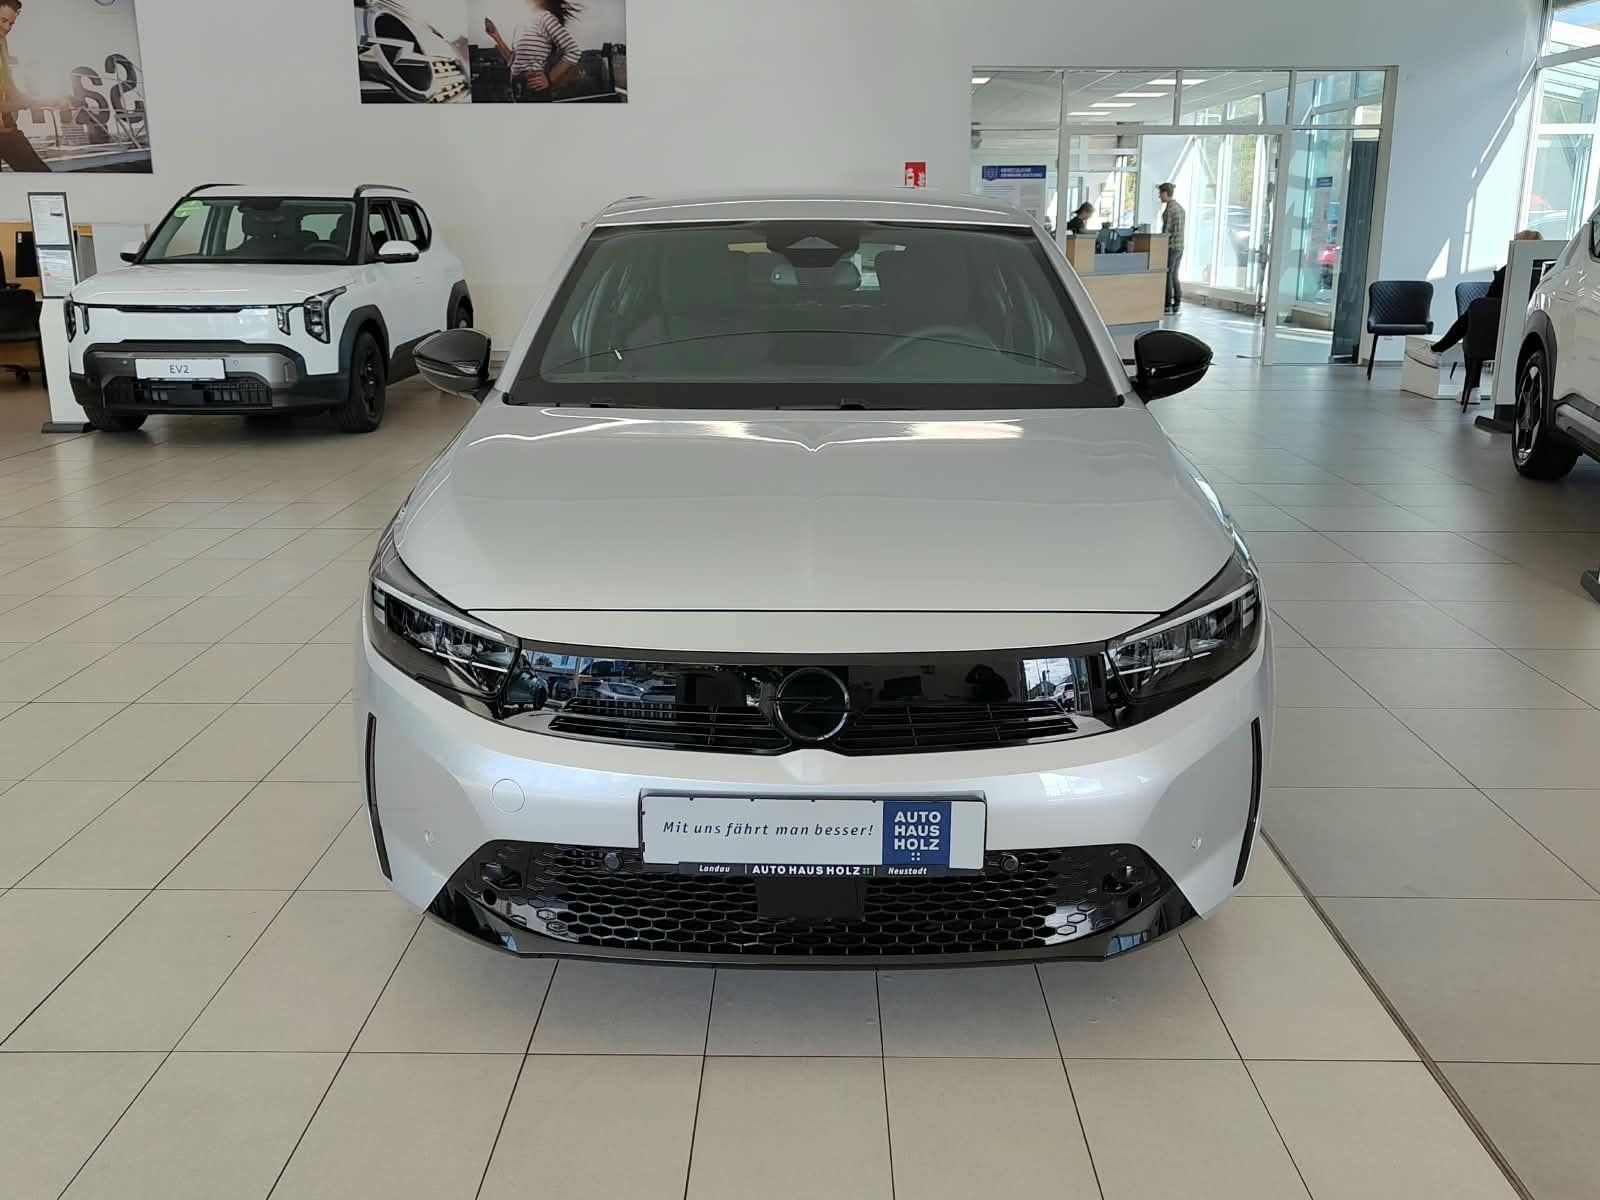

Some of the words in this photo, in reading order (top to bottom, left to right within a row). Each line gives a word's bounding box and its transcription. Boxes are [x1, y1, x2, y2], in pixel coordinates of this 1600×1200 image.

[169, 364, 190, 374] EV2
[894, 811, 942, 823] AUTO
[663, 821, 689, 834] Mit
[694, 825, 721, 834] uns
[725, 822, 769, 837] fährt
[775, 825, 809, 836] man
[814, 824, 874, 836] besser!
[894, 825, 940, 837] HAUS
[894, 838, 940, 850] HOLZ
[698, 864, 731, 873] Landau
[826, 866, 861, 876] HOLZ
[887, 866, 928, 875] Neustadt
